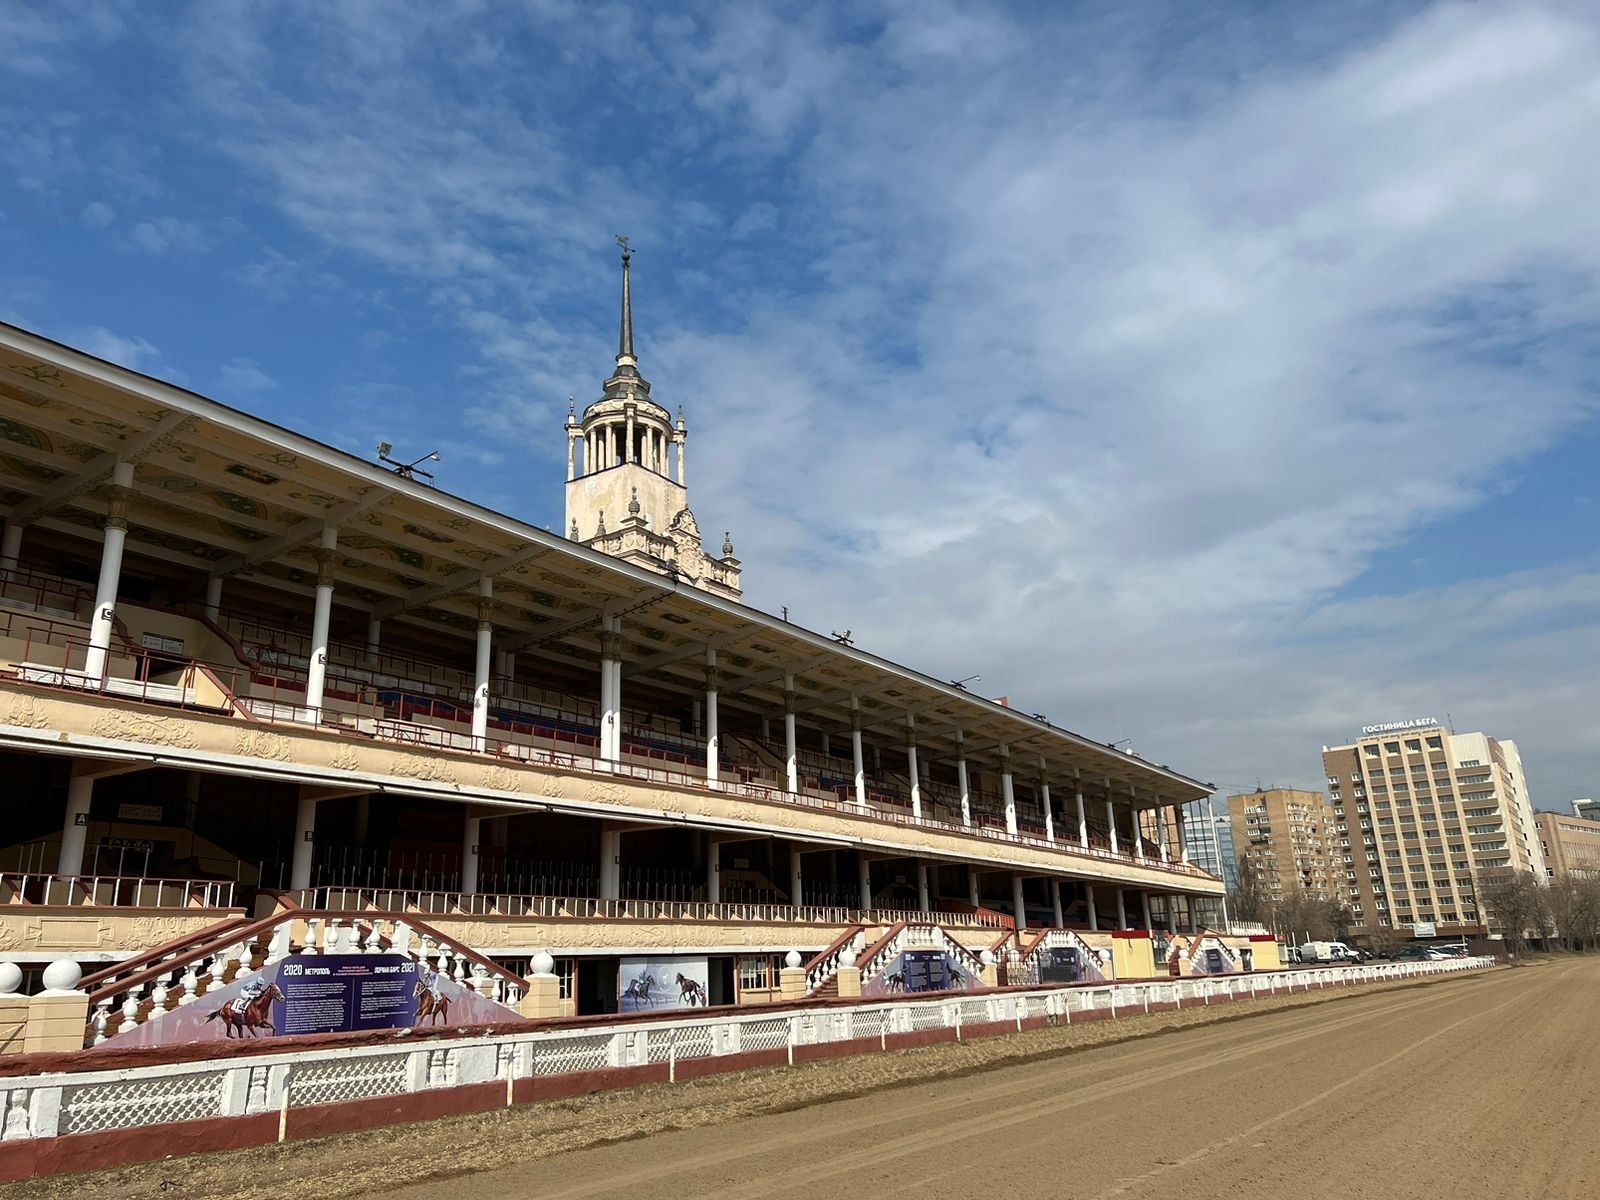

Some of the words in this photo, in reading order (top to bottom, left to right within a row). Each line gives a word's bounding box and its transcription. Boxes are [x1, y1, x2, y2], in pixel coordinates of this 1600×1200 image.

[1362, 720, 1415, 733] ГОСТИНИЦА
[1415, 717, 1437, 726] БЕГА
[284, 964, 303, 976] 2020
[305, 967, 331, 975] МЕТРОПОЛЬ
[400, 962, 415, 973] 2021
